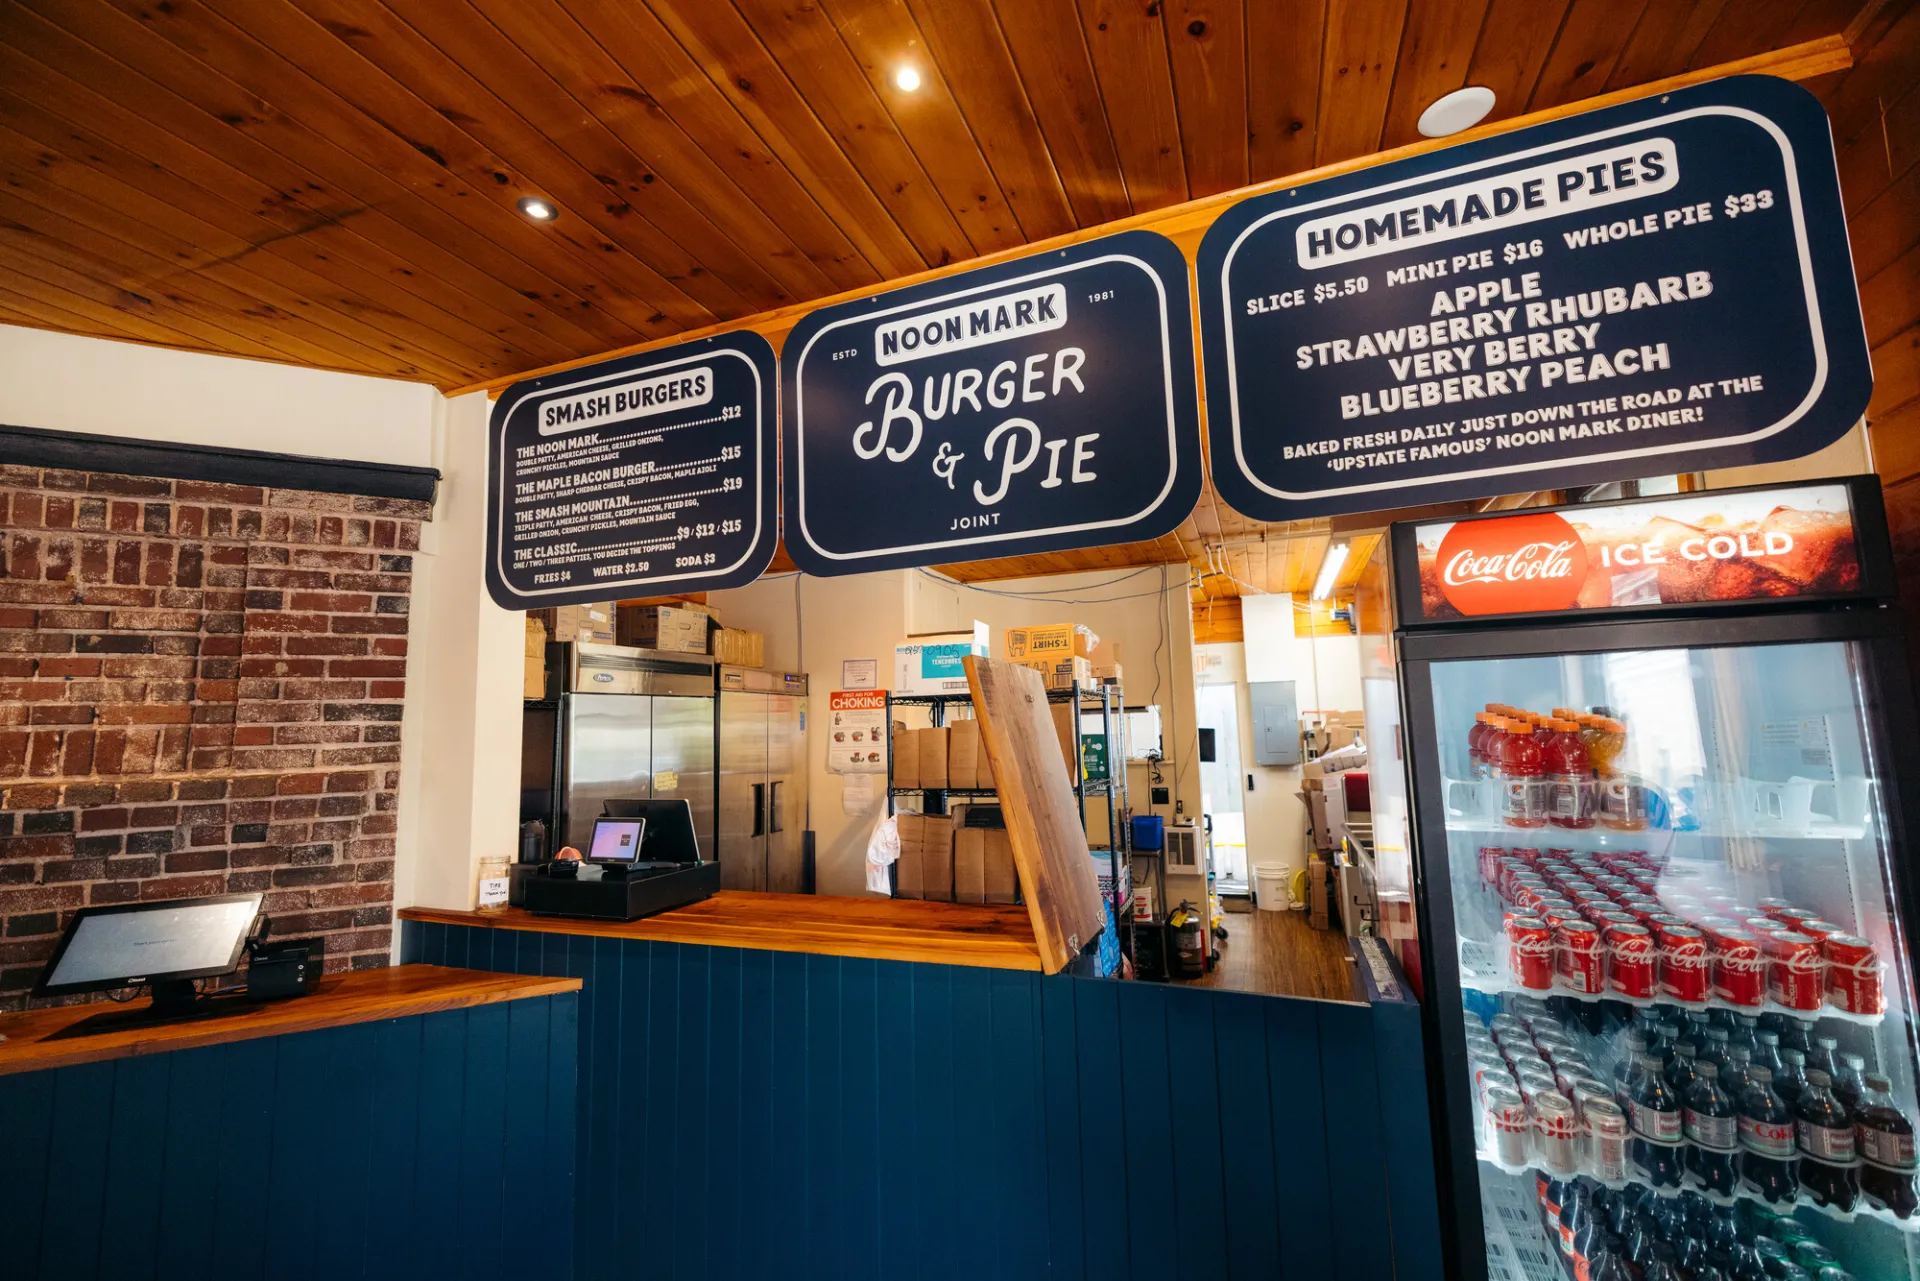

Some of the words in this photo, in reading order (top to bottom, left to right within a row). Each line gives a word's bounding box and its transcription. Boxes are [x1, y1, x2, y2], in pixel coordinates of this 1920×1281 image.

[1308, 178, 1546, 258] HOMEMADE
[1557, 150, 1667, 203] PIES
[1246, 289, 1306, 315] SLICE
[1314, 276, 1370, 303] $5.50
[1386, 259, 1448, 288] MINI
[1452, 250, 1494, 274] PIE
[1503, 238, 1544, 264] $16
[1563, 214, 1660, 250] WHOLE
[1664, 202, 1714, 230] PIE
[1724, 190, 1774, 218] $33
[1088, 290, 1115, 304] 1981
[1430, 272, 1543, 316] APPLE
[882, 314, 964, 358] NOON
[970, 293, 1058, 336] MARK
[1296, 307, 1518, 370] STRAWBERRY
[1525, 270, 1714, 328] RHUBARB
[832, 348, 858, 361] ESTD
[1388, 345, 1476, 381] VERY
[1484, 322, 1600, 366] BERRY
[546, 396, 610, 426] SMASH
[616, 375, 706, 412] BURGERS
[1340, 366, 1531, 420] BLUEBERRY
[1540, 342, 1670, 388] PEACH
[852, 347, 1086, 462] BURGER
[1283, 440, 1340, 460] BAKED
[1343, 430, 1398, 451] FRESH
[1400, 422, 1456, 443] DAILY
[1460, 414, 1508, 434] JUST
[1511, 404, 1574, 427] DOWN
[1578, 398, 1618, 416] THE
[1621, 388, 1683, 411] ROAD
[1687, 382, 1714, 402] AT
[1718, 375, 1764, 396] THE
[516, 447, 535, 459] THE
[537, 440, 566, 455] NOON
[722, 405, 741, 422] $12
[1496, 428, 1555, 450] NOON
[1559, 418, 1624, 441] MARK
[1627, 406, 1704, 432] DINER!
[516, 458, 538, 468] DOUBLE
[538, 455, 556, 466] PATTY,
[557, 449, 587, 460] AMERICAN
[588, 445, 611, 454] CHEESE,
[612, 440, 636, 450] GRILLED
[637, 434, 664, 446] ONIONS,
[516, 466, 542, 476] CRUNCHY
[543, 462, 568, 472] PICKLES,
[568, 456, 600, 467] MOUNTAIN
[601, 452, 620, 462] SAUCE
[516, 482, 534, 495] THE
[537, 474, 572, 492] MAPLE
[574, 469, 610, 486] BACON
[722, 445, 741, 462] $15
[932, 442, 965, 490] &
[973, 418, 1100, 506] PIE
[515, 510, 533, 522] THE
[536, 504, 570, 520] SMASH
[724, 477, 742, 492] $19
[516, 495, 536, 504] DOUBLE
[537, 492, 555, 502] PATTY,
[556, 488, 574, 498] SHARP
[576, 484, 602, 495] CHEDDAR
[603, 480, 626, 490] CHEESE,
[627, 476, 649, 486] CRISPY
[650, 472, 673, 482] BACON,
[674, 468, 696, 478] MAPLE
[697, 465, 716, 474] AIOLI
[514, 532, 538, 541] GRILLED
[539, 529, 560, 538] ONION,
[562, 524, 590, 534] CRUNCHY
[591, 520, 618, 530] PICKLES,
[620, 515, 654, 526] MOUNTAIN
[656, 512, 676, 520] SAUCE
[536, 520, 555, 528] PATTY,
[556, 516, 588, 526] AMERICAN
[590, 512, 614, 520] CHEESE,
[614, 506, 638, 517] CRISPY
[639, 504, 662, 514] BACON,
[664, 500, 684, 510] FRIED
[950, 513, 1000, 531] JOINT
[514, 548, 532, 560] THE
[677, 526, 690, 540] $9
[696, 523, 715, 538] $12
[722, 520, 742, 535] $15
[547, 558, 565, 566] THREE
[566, 554, 592, 563] PATTIES,
[593, 552, 606, 560] YOU
[606, 548, 629, 558] DECIDE
[630, 546, 642, 555] THE
[642, 542, 676, 552] TOPPINGS
[1600, 542, 1666, 567] ICE
[1680, 532, 1794, 560] COLD
[534, 572, 560, 584] FRIES
[560, 570, 571, 582] $4
[593, 564, 624, 578] WATER
[625, 562, 650, 574] $2.50
[676, 555, 702, 568] SODA
[704, 553, 716, 565] $3
[832, 696, 884, 709] CHOKING
